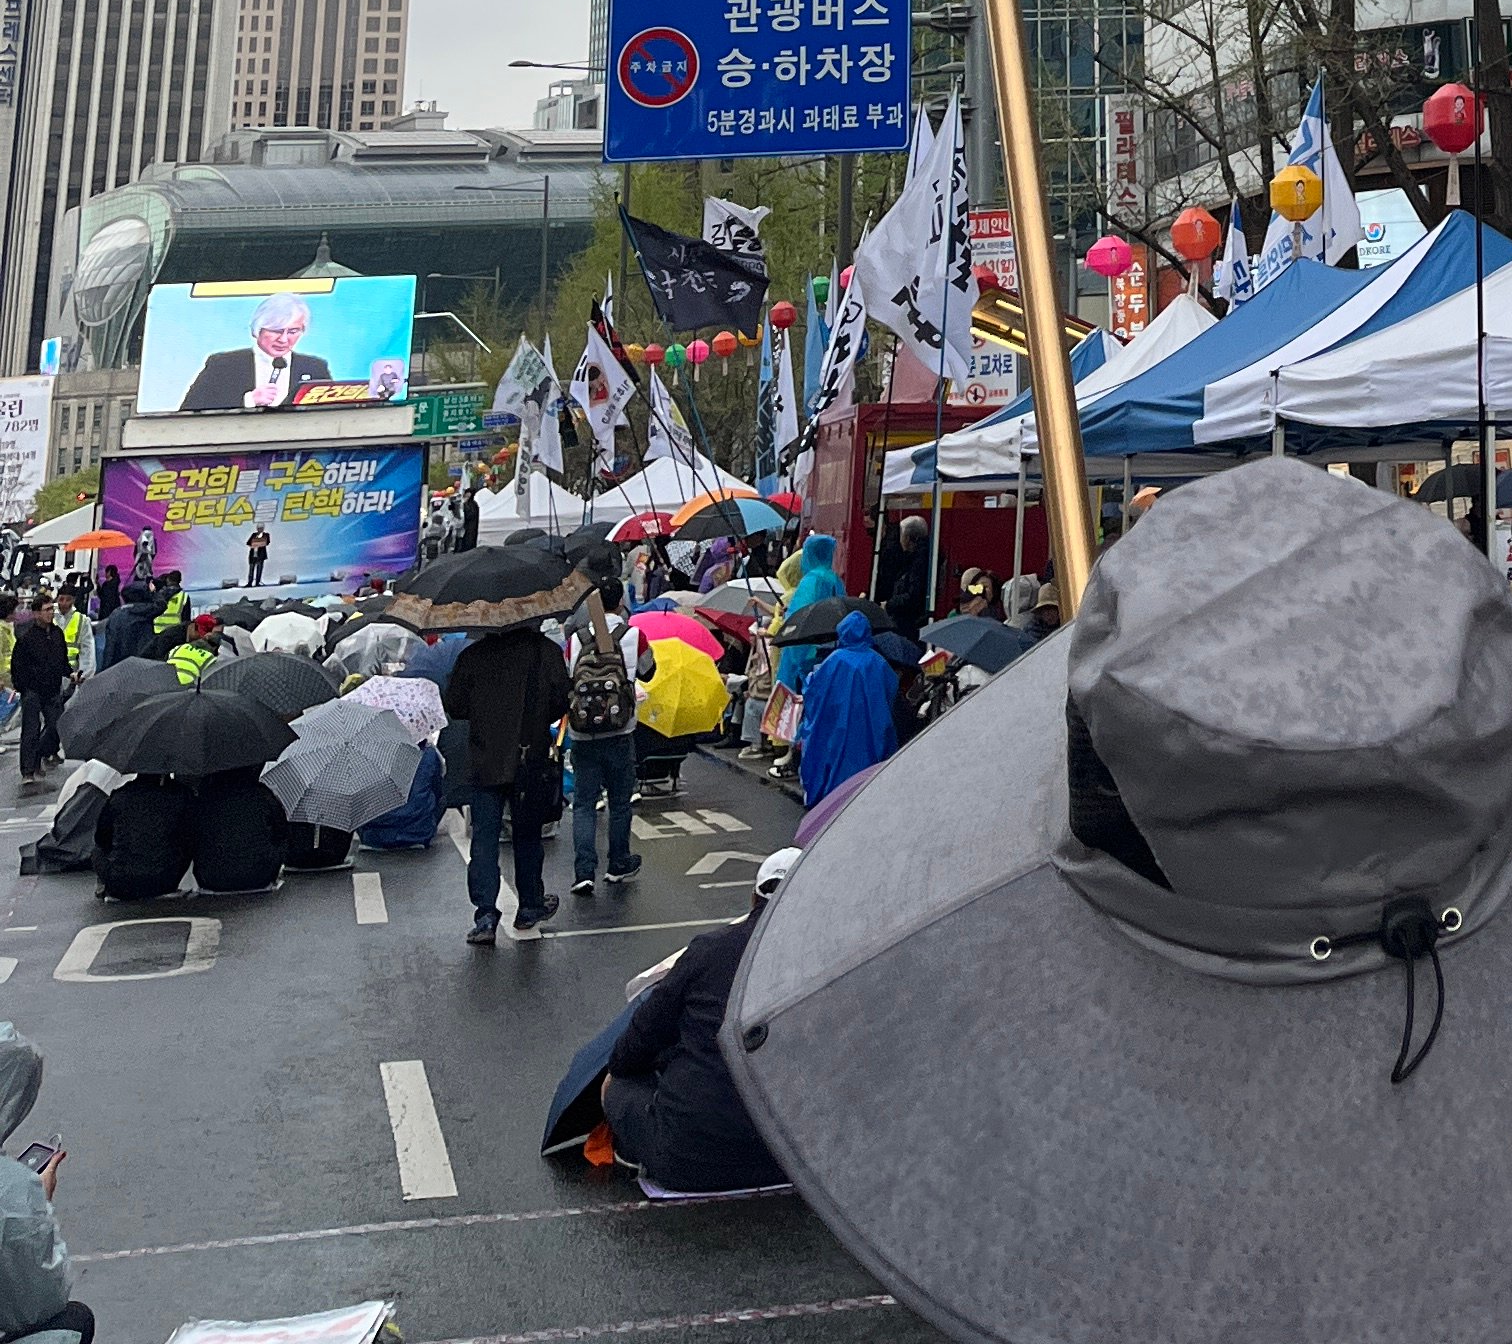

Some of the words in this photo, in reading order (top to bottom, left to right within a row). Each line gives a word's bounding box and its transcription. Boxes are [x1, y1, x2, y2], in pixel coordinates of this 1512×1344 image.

[629, 58, 688, 75] 주차금지
[716, 44, 896, 89] 승·하차장
[707, 106, 795, 135] 5분경과시
[802, 103, 860, 132] 과태료
[866, 99, 904, 129] 부과
[1115, 112, 1138, 207] 필라테스
[145, 465, 261, 502] 윤건희를
[265, 459, 378, 491] 구속하라!
[162, 496, 279, 532] 한덕수를
[281, 487, 395, 522] 탄핵하라!
